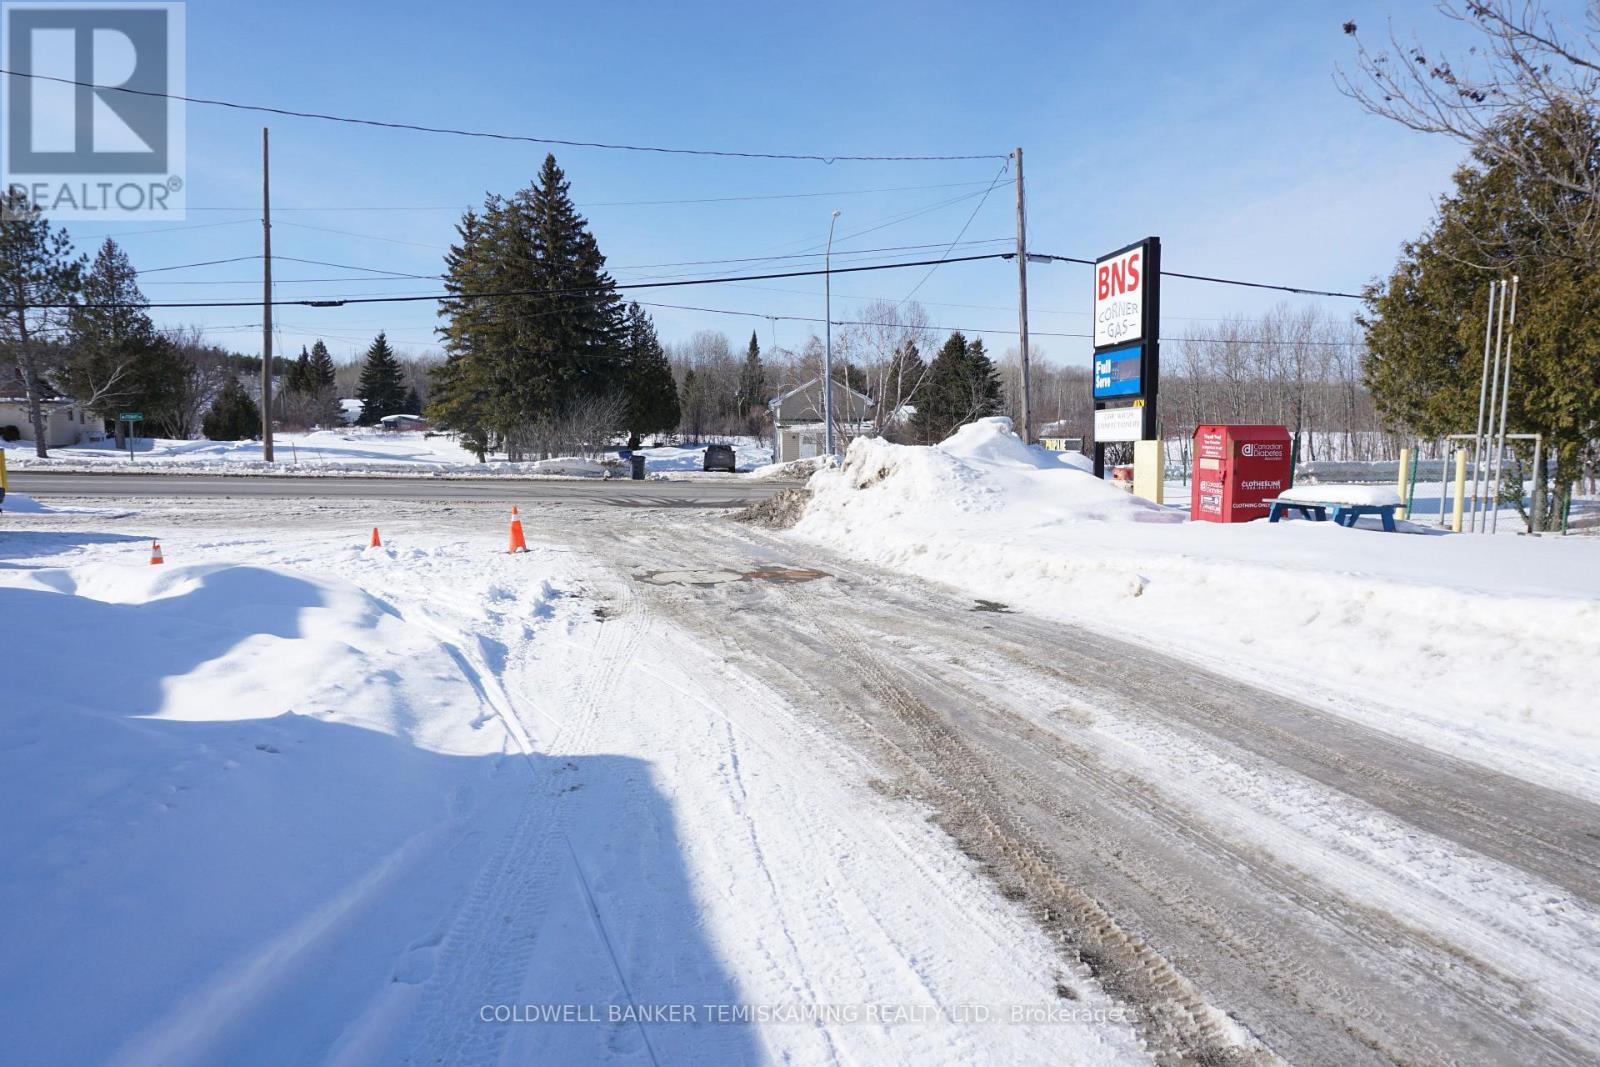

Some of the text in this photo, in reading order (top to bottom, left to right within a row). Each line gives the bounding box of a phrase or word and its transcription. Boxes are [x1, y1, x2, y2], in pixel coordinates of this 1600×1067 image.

[1098, 253, 1140, 301] BNS
[1098, 301, 1138, 323] CORNER
[1095, 359, 1111, 375] Full
[1095, 374, 1111, 389] Serve
[1241, 479, 1281, 487] CLOTHESLINE
